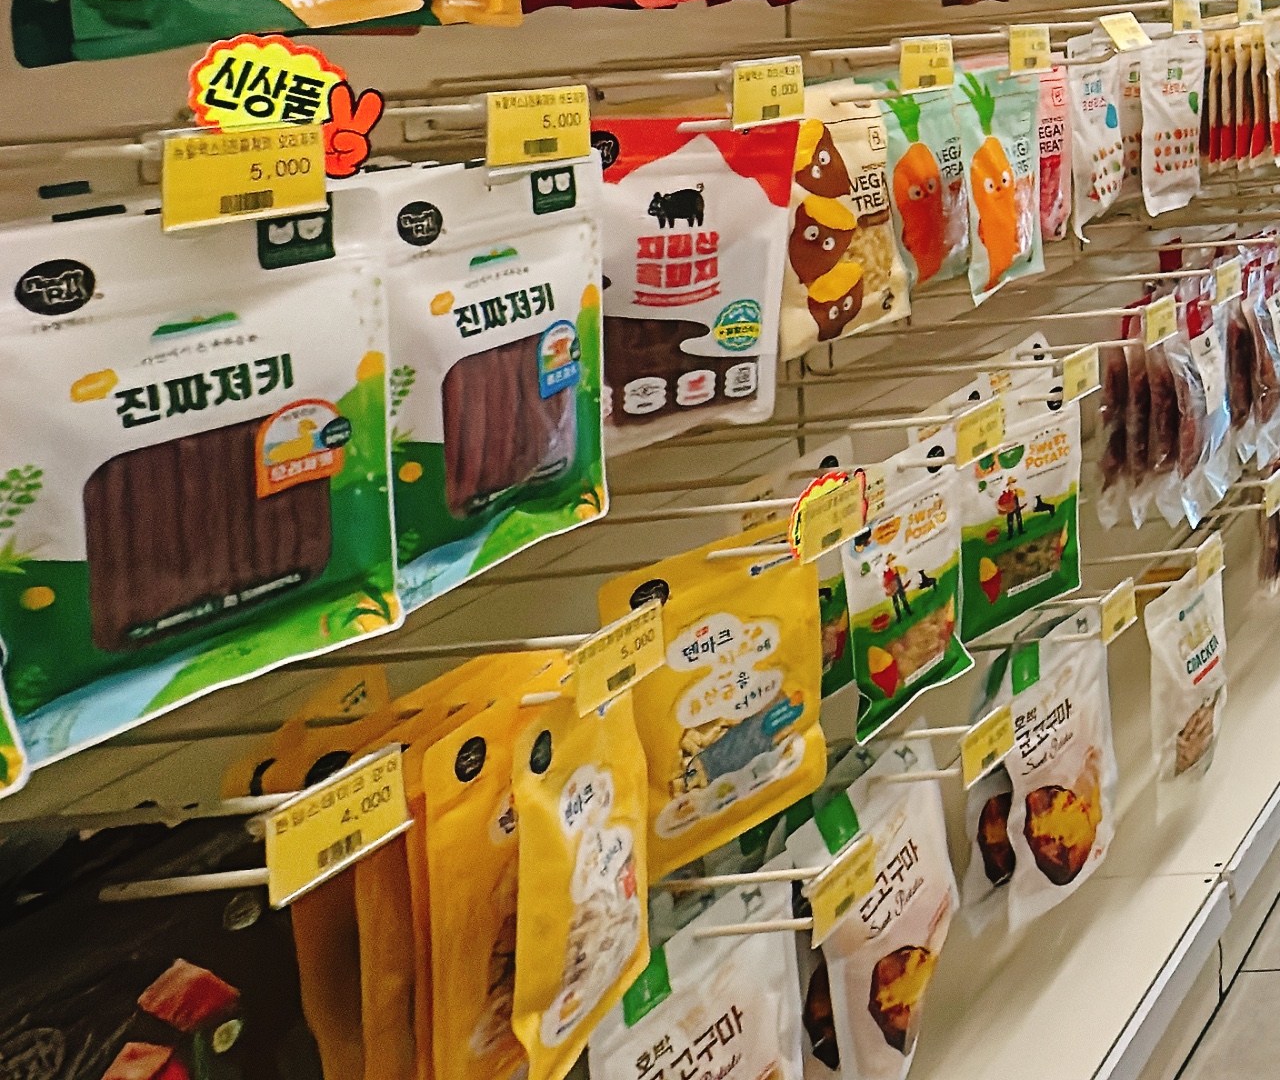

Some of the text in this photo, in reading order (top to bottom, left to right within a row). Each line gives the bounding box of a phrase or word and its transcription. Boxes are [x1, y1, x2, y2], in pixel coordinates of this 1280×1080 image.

[205, 57, 325, 124] 신상품
[250, 157, 311, 180] 5,000
[1025, 444, 1071, 471] POTATO
[1028, 433, 1068, 457] SWEET
